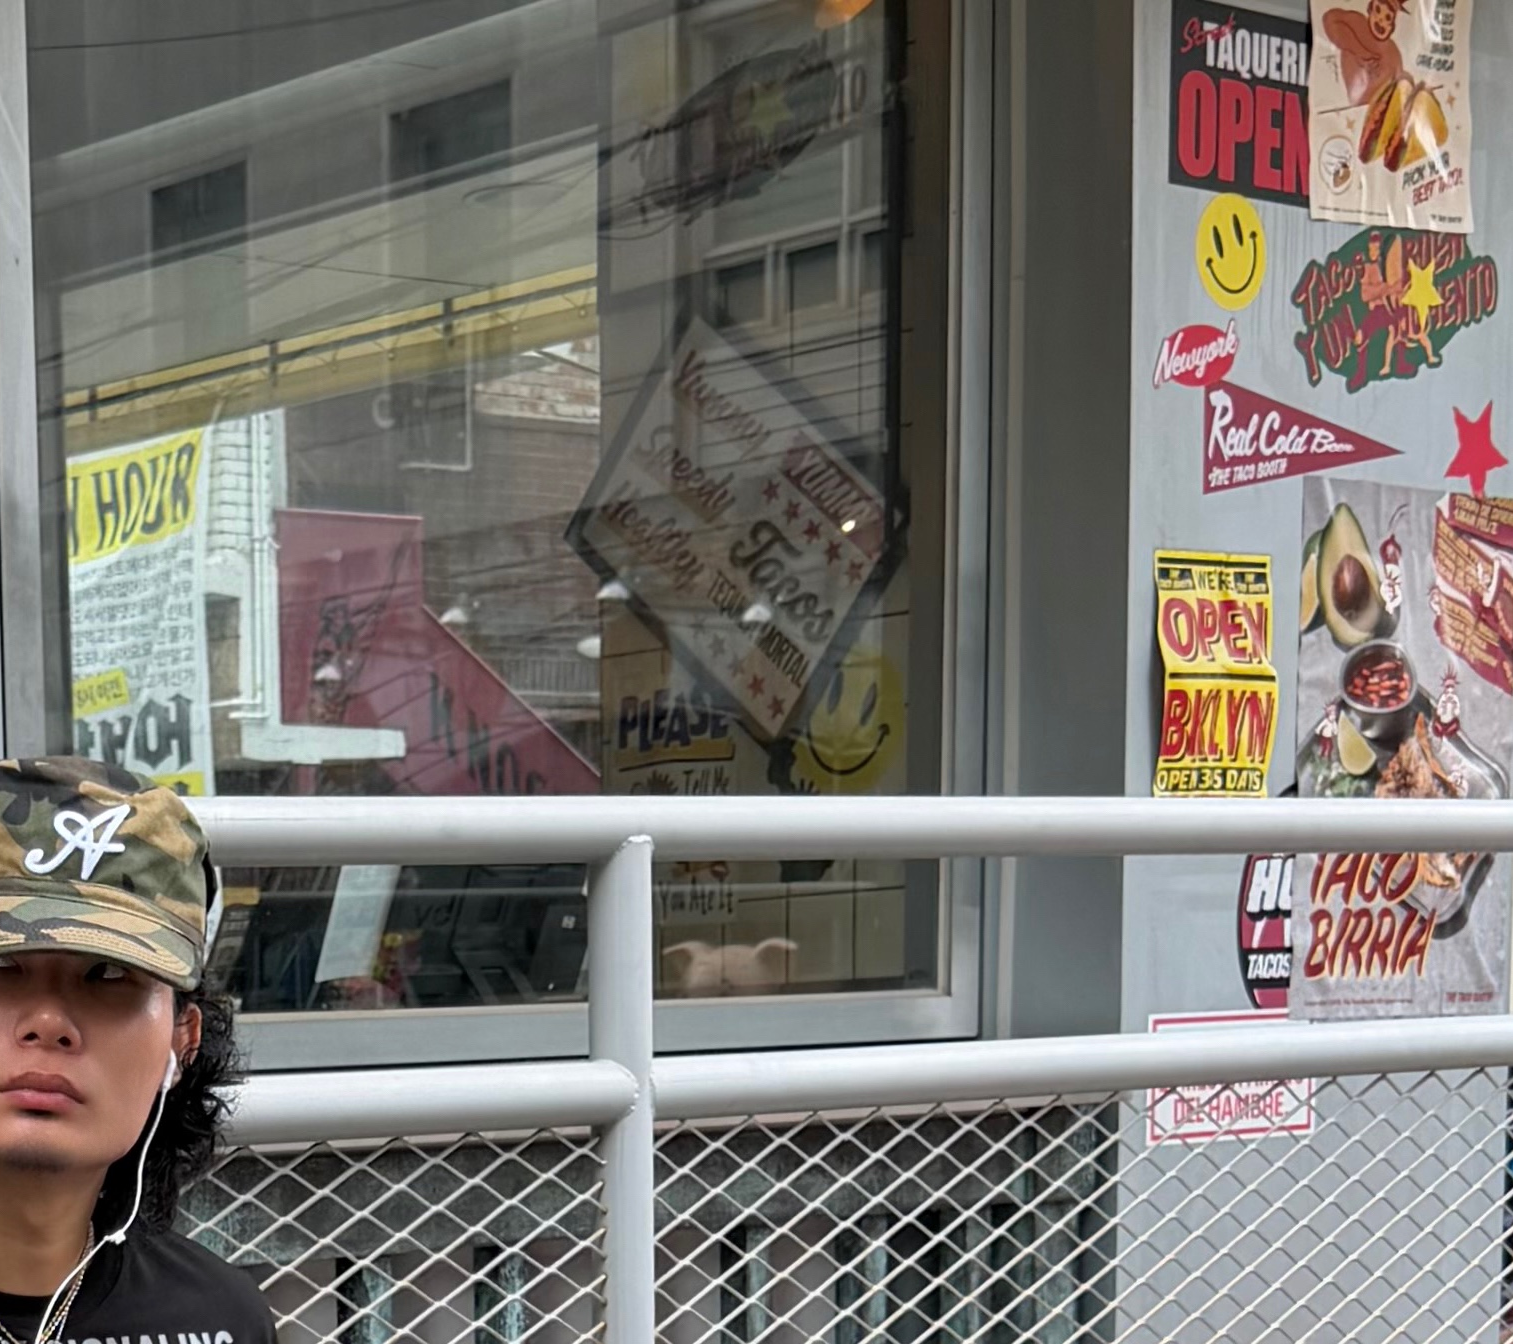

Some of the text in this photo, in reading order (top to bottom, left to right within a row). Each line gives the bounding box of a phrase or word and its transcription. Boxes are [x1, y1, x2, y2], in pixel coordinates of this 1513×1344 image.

[1203, 21, 1310, 87] TAQUERI
[1178, 70, 1310, 196] OPEN
[1209, 390, 1260, 461] Real
[1260, 411, 1310, 456] Cold
[92, 441, 196, 551] HOUR
[729, 519, 835, 645] Tacos
[1162, 598, 1268, 664] OPEN
[618, 690, 729, 754] PLEASE
[1160, 689, 1275, 764] BKLYN
[1156, 769, 1197, 791] OPEN
[1304, 907, 1437, 981] BIRRIA
